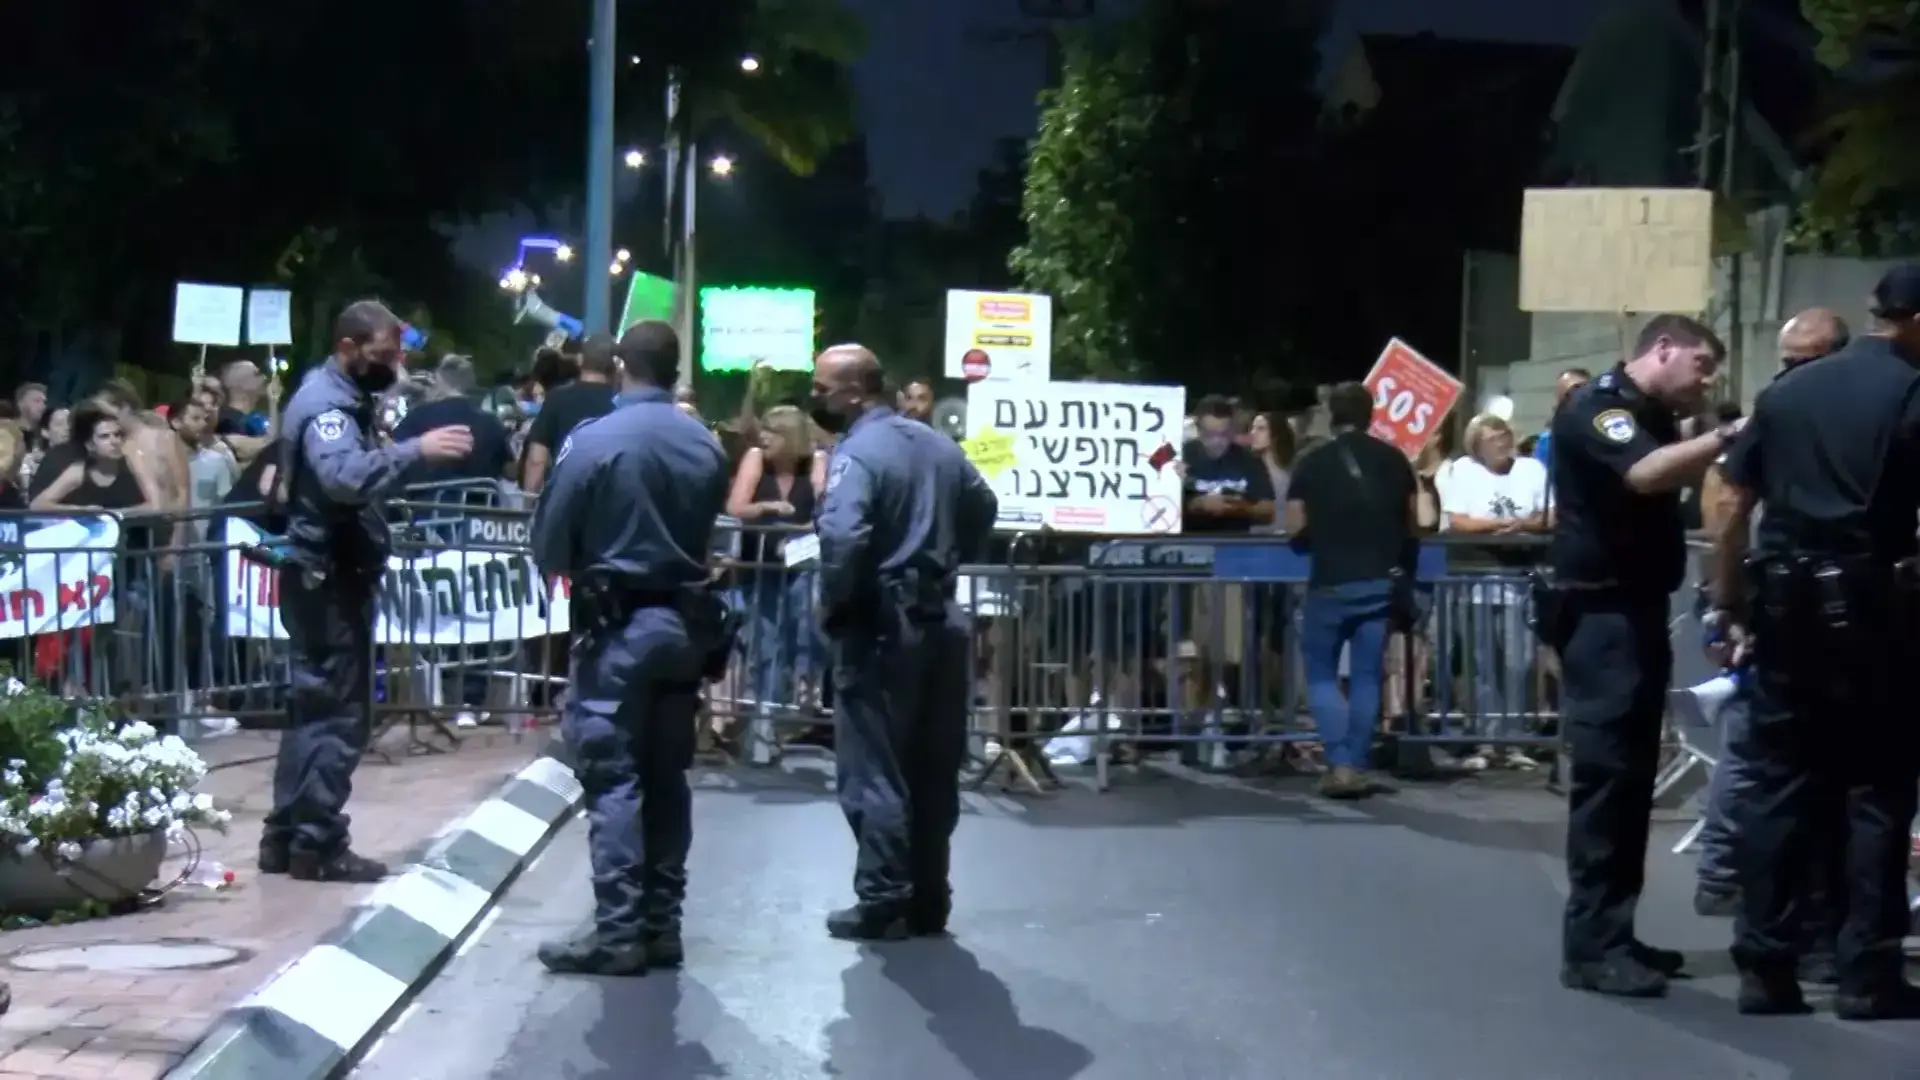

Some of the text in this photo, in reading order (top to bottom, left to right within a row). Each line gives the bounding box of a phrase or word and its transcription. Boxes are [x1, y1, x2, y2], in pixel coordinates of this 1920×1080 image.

[994, 399, 1164, 432] להיות עם
[1373, 376, 1434, 435] SOS
[1027, 435, 1138, 468] חופשי
[470, 518, 531, 543] POLIC
